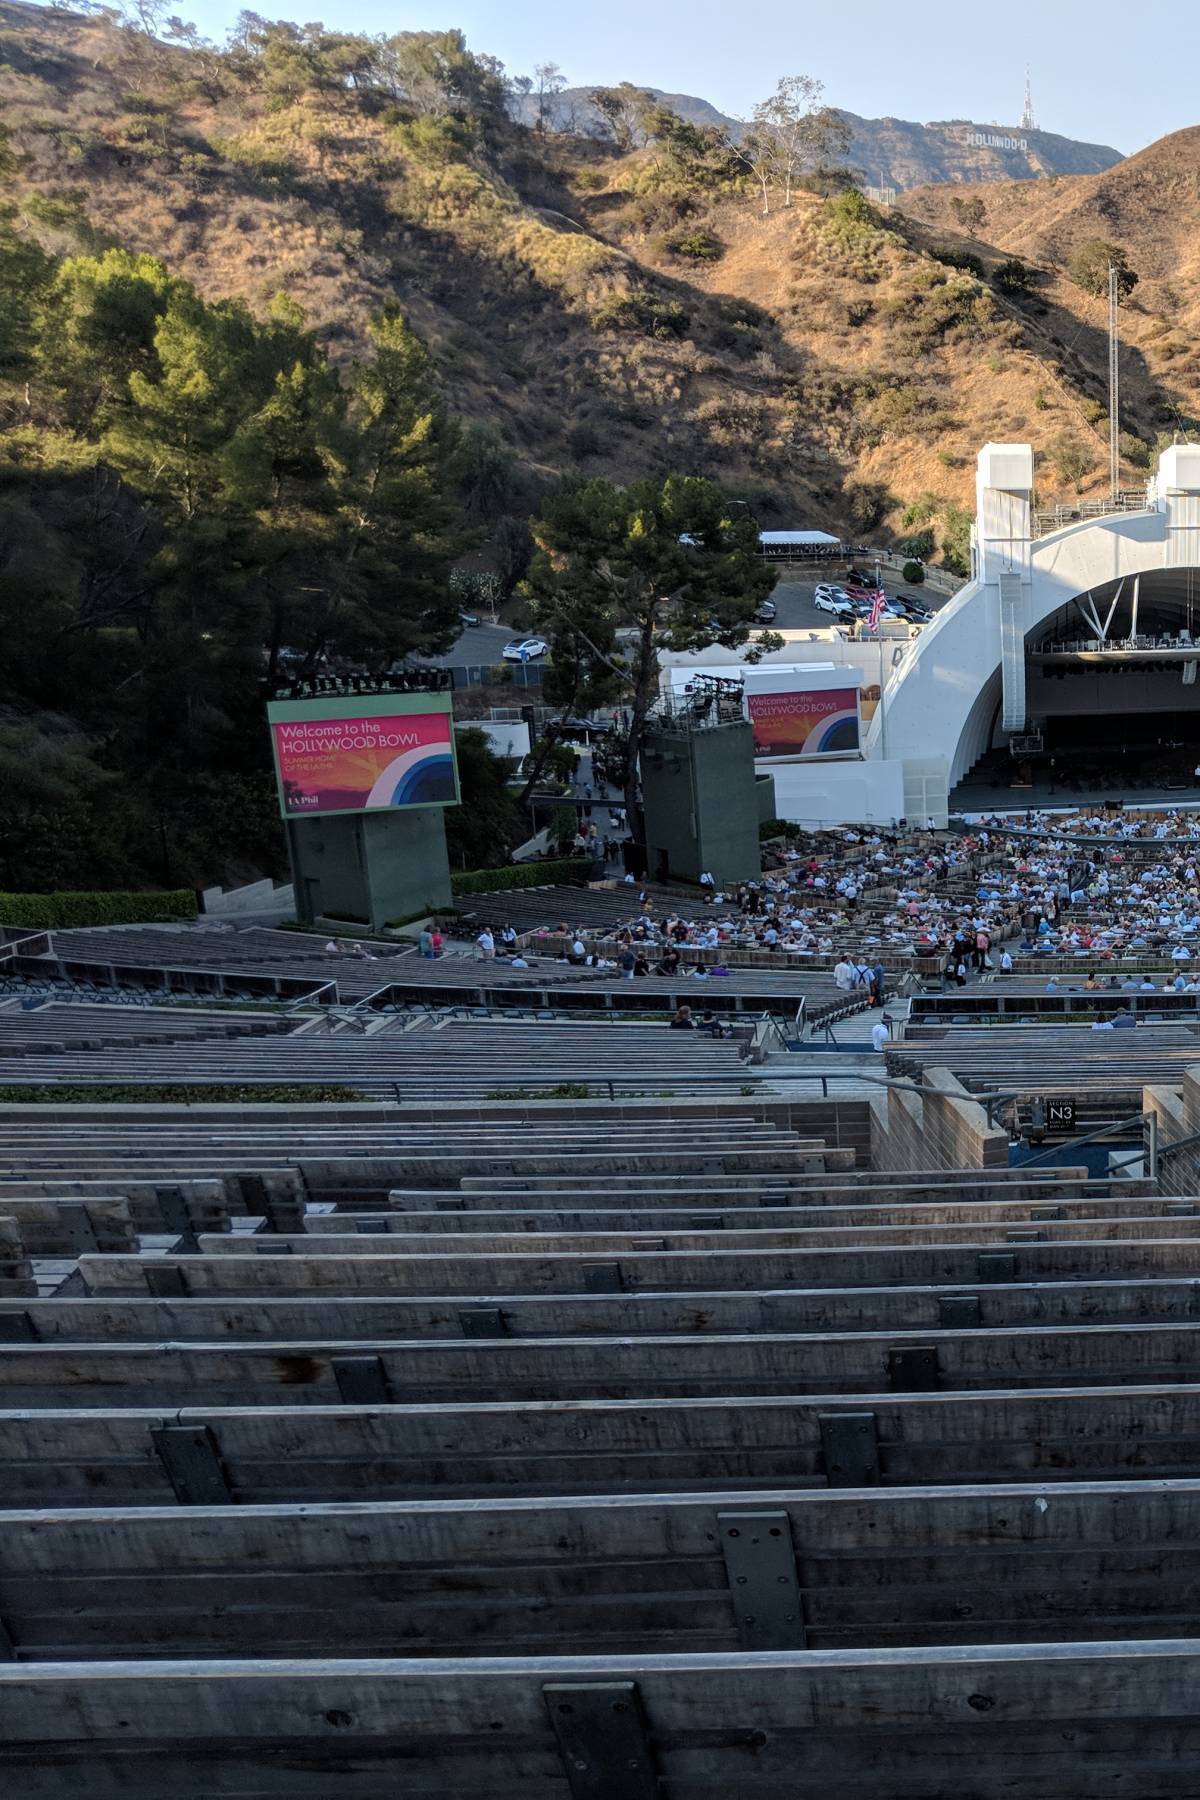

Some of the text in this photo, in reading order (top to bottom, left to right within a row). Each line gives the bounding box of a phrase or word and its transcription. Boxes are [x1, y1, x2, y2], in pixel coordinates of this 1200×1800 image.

[749, 697, 788, 706] Welcome
[800, 695, 813, 703] the
[749, 702, 838, 717] HOLLYWOOD BOWL
[281, 720, 381, 738] Welcome to the
[282, 733, 421, 753] HOLLYWOOD BOWL
[301, 796, 319, 804] Phil
[1050, 1106, 1072, 1119] N3
